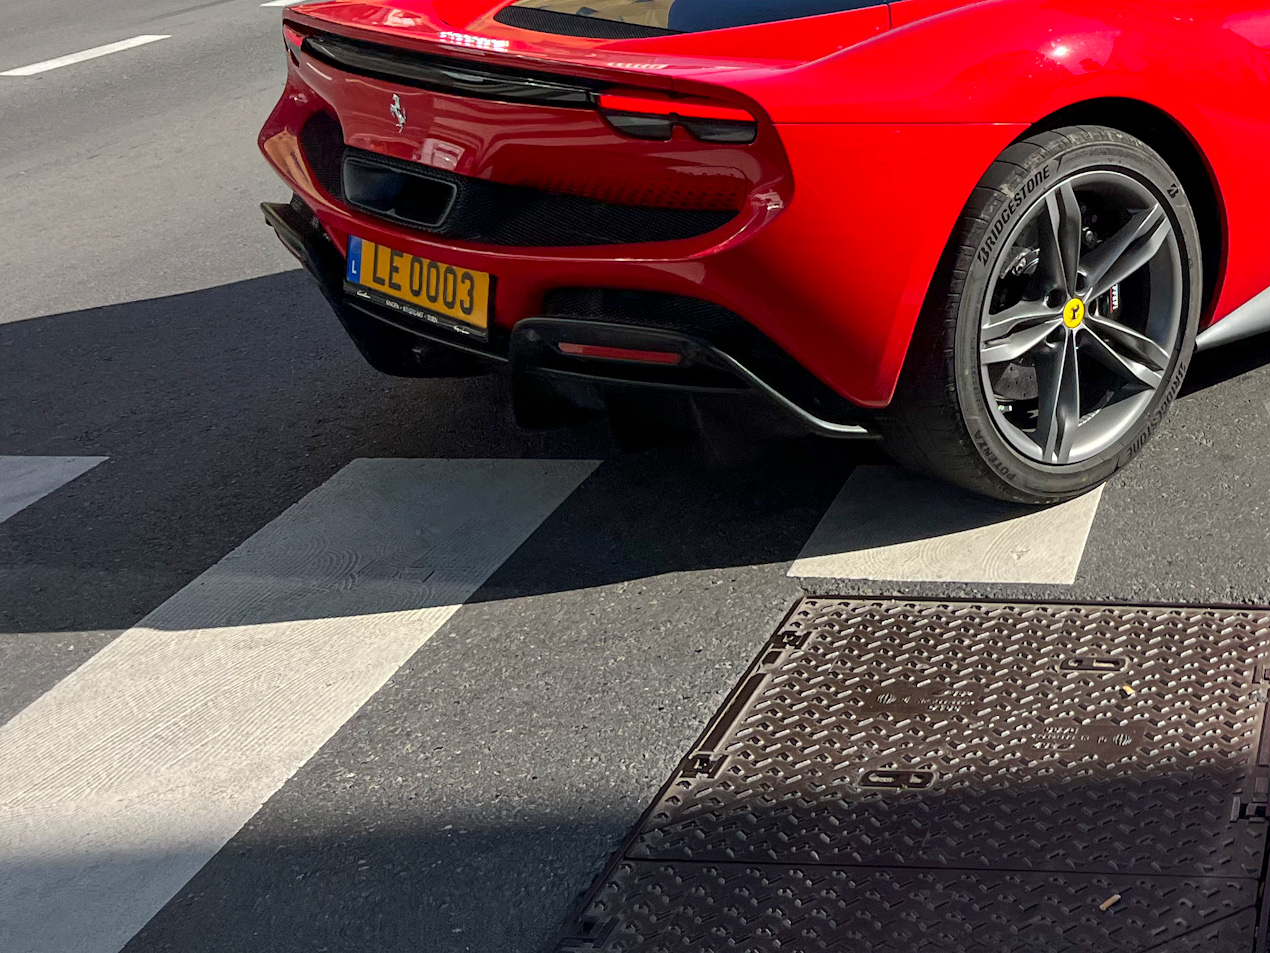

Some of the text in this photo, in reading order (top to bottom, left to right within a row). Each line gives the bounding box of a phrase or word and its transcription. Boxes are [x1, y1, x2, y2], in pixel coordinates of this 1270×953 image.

[978, 164, 1050, 266] BRIDGESTONE
[352, 260, 357, 274] L
[372, 244, 475, 316] LE 0003
[974, 429, 1017, 481] POTENZA
